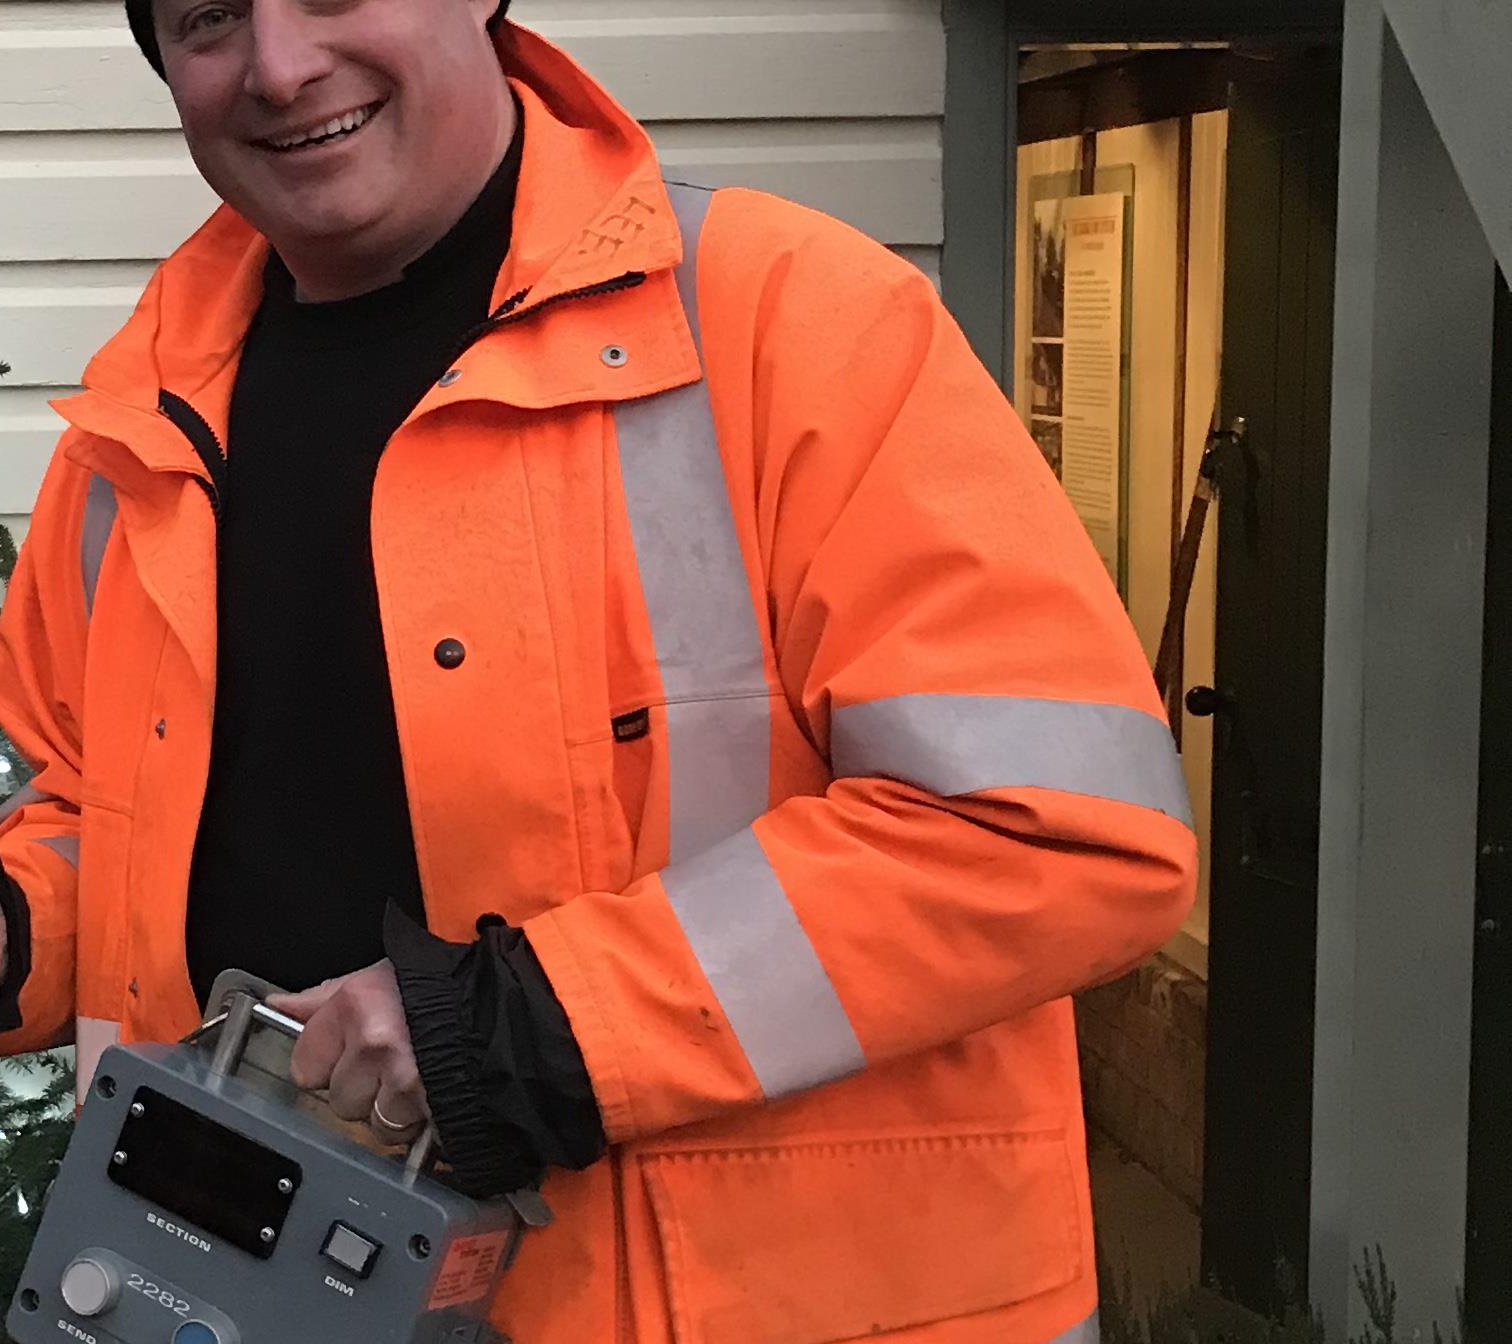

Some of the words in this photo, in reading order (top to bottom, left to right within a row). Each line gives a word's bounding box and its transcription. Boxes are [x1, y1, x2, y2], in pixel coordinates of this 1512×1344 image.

[146, 1212, 212, 1253] SECTION
[126, 1273, 191, 1319] 2282
[324, 1275, 355, 1297] DIM
